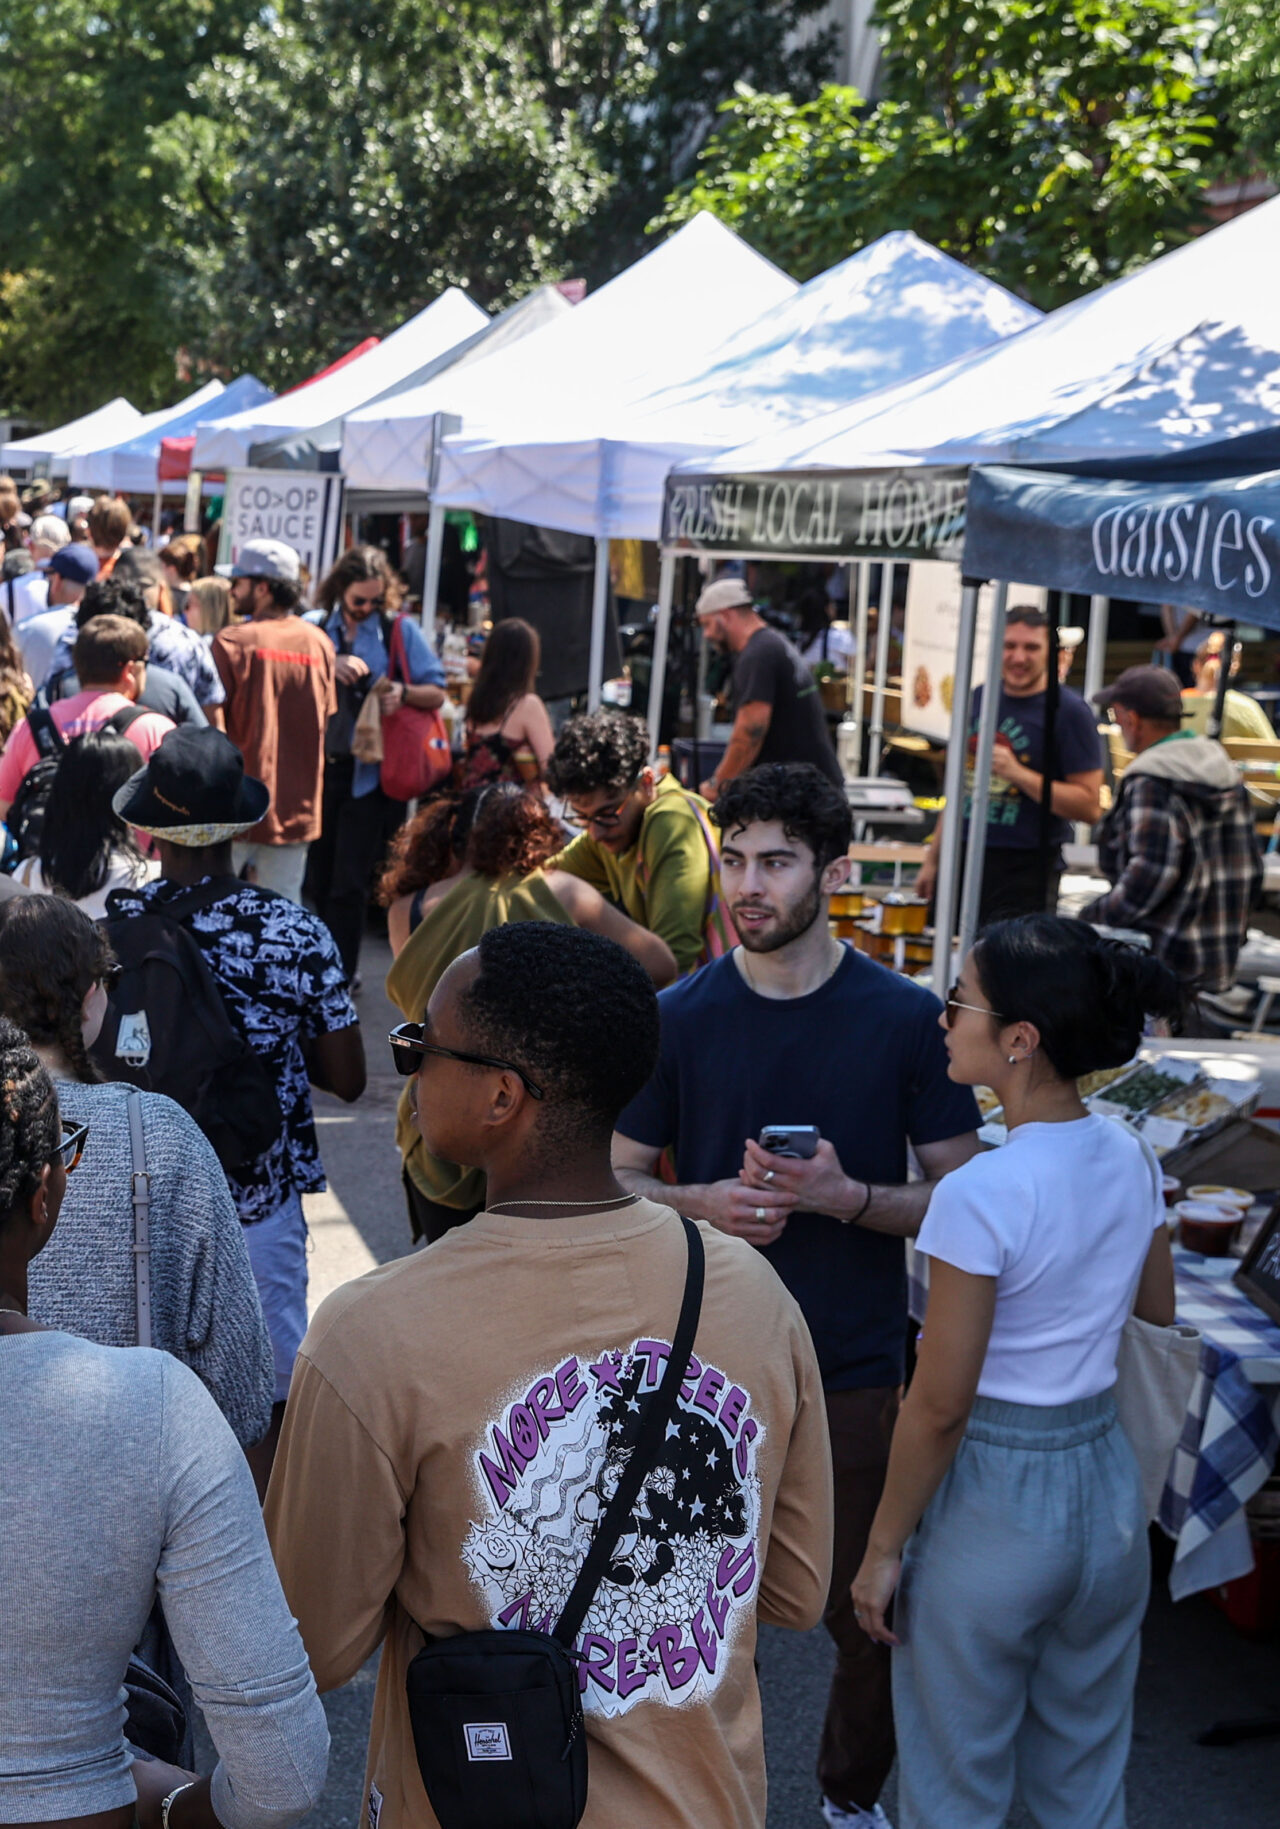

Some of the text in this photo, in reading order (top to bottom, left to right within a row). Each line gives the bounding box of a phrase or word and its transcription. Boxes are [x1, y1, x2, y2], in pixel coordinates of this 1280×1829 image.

[238, 513, 315, 539] SAUCE
[669, 477, 969, 550] FRESH LOCAL HONE
[1092, 499, 1276, 598] daisies
[478, 1356, 588, 1508] MORE
[649, 1540, 756, 1691] BEES
